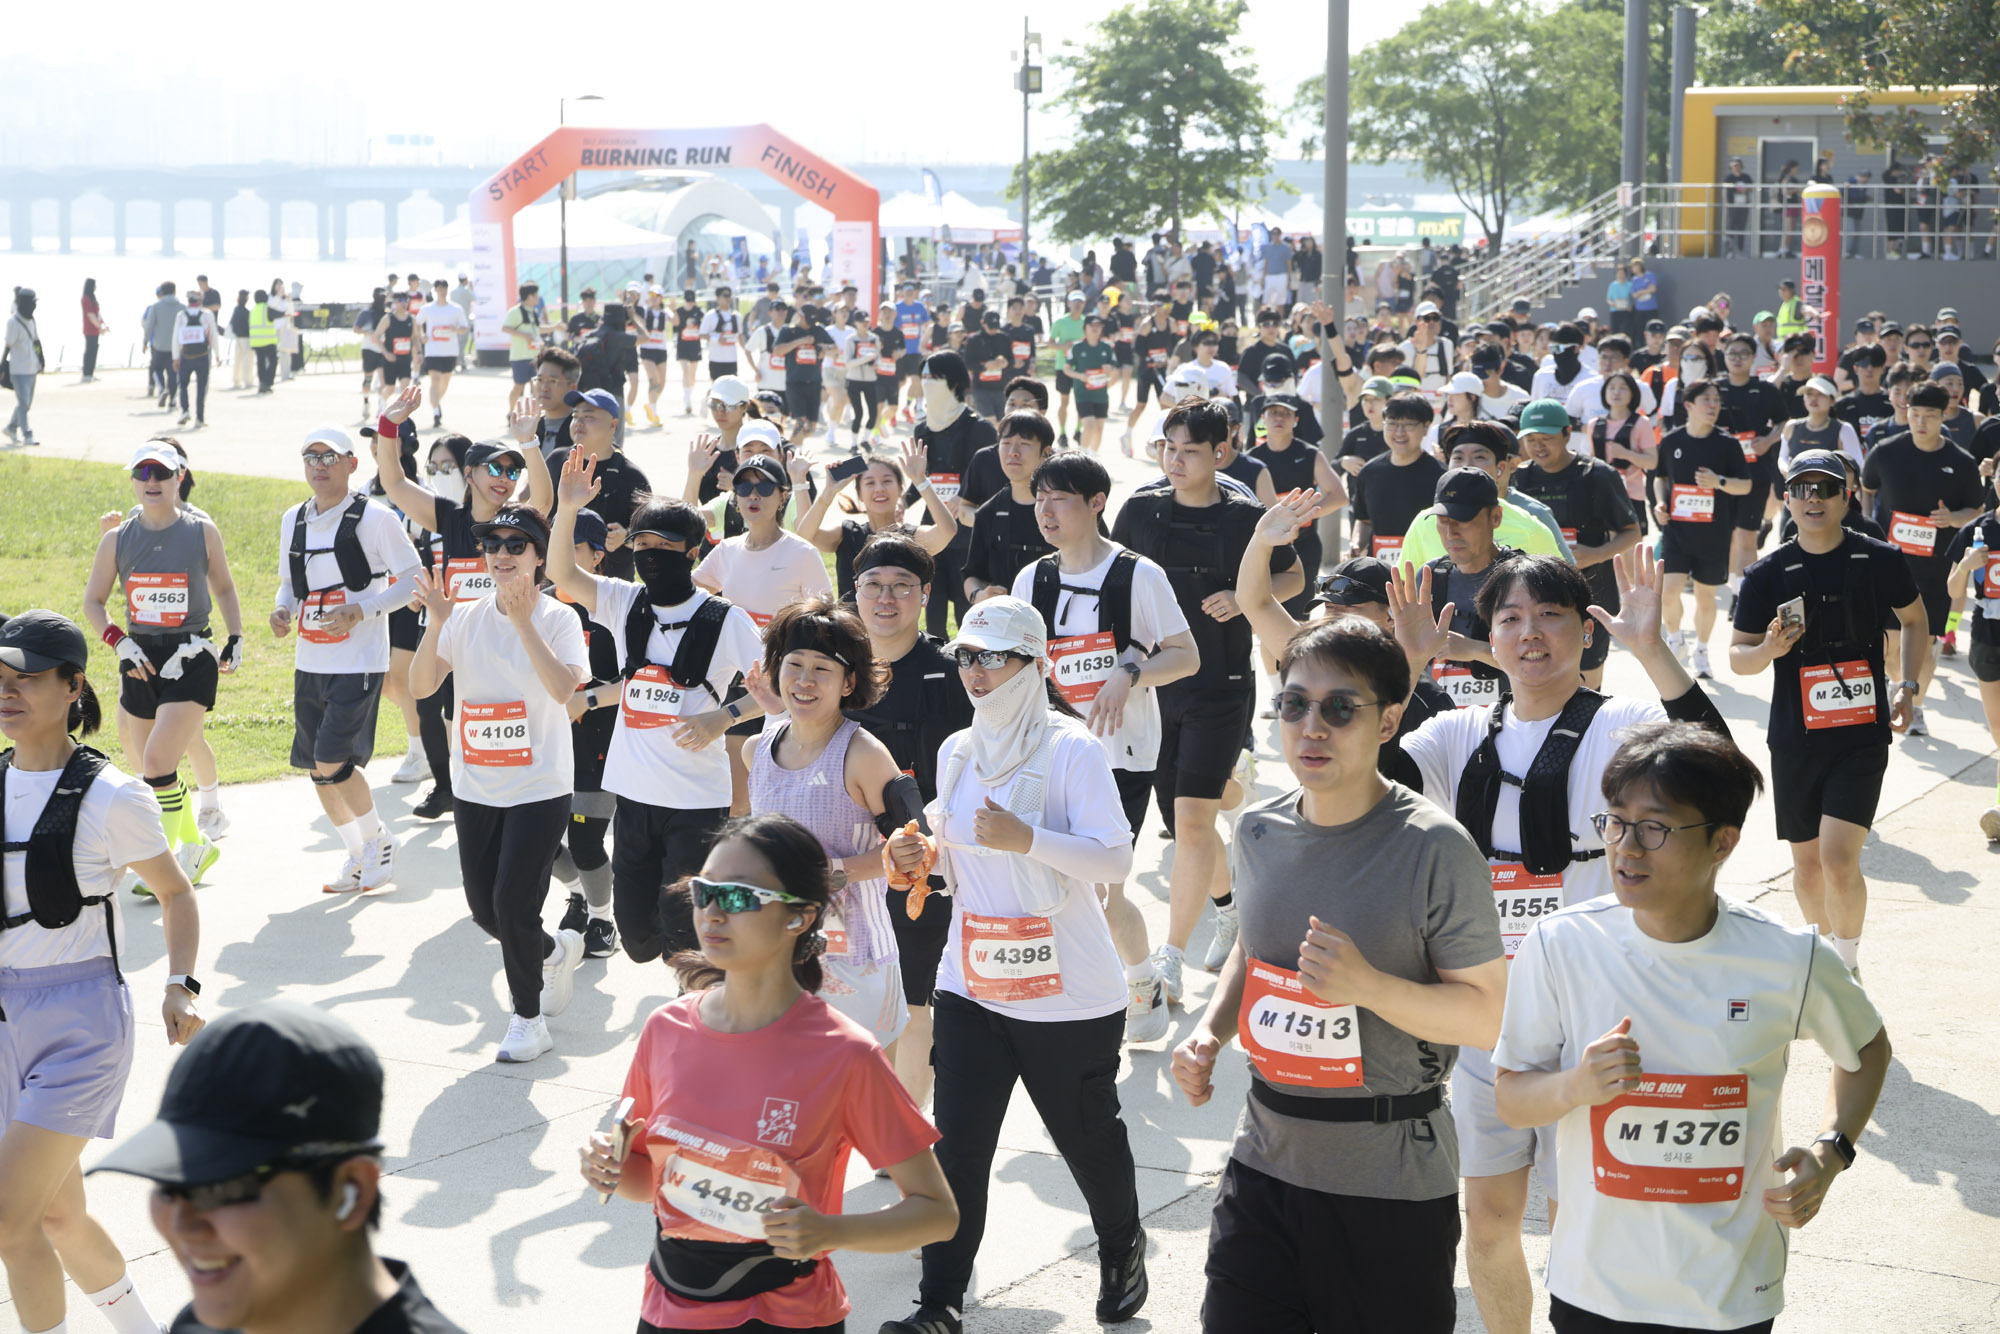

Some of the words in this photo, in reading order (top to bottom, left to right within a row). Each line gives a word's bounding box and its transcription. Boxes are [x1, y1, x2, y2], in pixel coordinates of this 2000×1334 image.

[580, 148, 678, 166] BURNING
[685, 146, 732, 165] RUN
[489, 148, 549, 201] START
[761, 145, 837, 201] FINISH
[1907, 529, 1933, 540] 1585
[465, 578, 496, 589] 466
[136, 594, 146, 602] W
[149, 592, 186, 603] 4563
[1061, 665, 1070, 674] M
[1074, 655, 1114, 672] 1639
[1452, 680, 1495, 694] 1638
[630, 688, 640, 698] M
[646, 688, 680, 704] 1998
[1816, 691, 1826, 700] M
[469, 729, 478, 738] W
[482, 725, 525, 739] 4108
[1497, 871, 1516, 879] RUN
[1498, 897, 1558, 917] 1555
[993, 922, 1008, 930] RUN
[976, 950, 988, 962] W
[993, 945, 1052, 964] 4398
[1252, 967, 1284, 985] BURNING
[1285, 978, 1302, 989] RUN
[1259, 1010, 1278, 1027] M
[1285, 1011, 1351, 1040] 1513
[1657, 1082, 1687, 1094] RUN
[1713, 1087, 1740, 1096] 10km
[1619, 1123, 1642, 1141] M
[1654, 1120, 1740, 1146] 1376
[656, 1126, 704, 1148] BURNING
[704, 1141, 731, 1158] RUN
[1664, 1152, 1693, 1163] 성시윤
[752, 1160, 783, 1174] 10km
[668, 1169, 686, 1188] W
